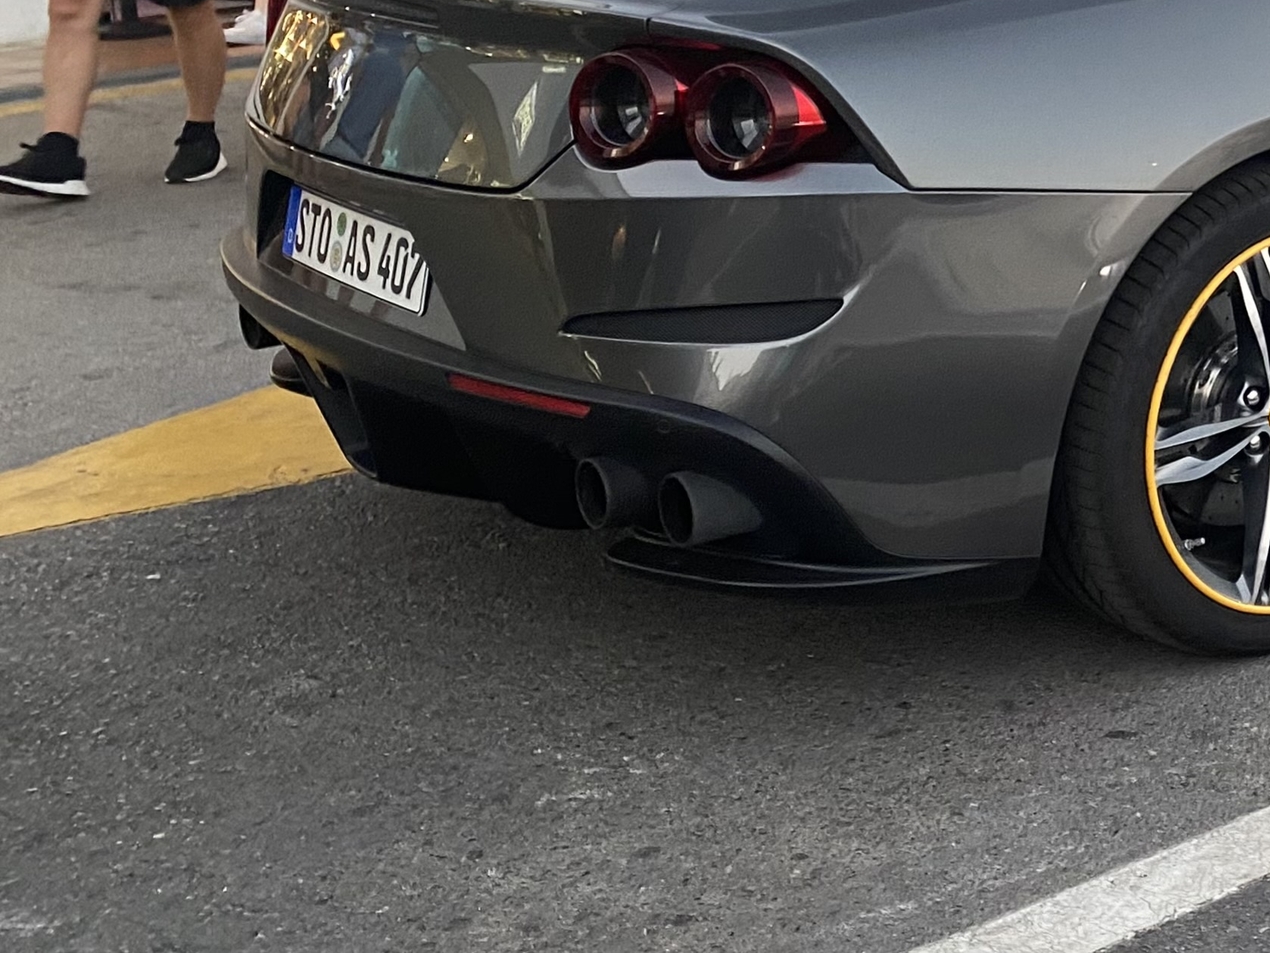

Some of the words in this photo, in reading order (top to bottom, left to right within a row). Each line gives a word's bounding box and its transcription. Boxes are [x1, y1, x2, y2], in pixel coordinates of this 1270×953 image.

[295, 198, 333, 264] STO
[342, 219, 376, 281] AS
[377, 232, 424, 300] 407
